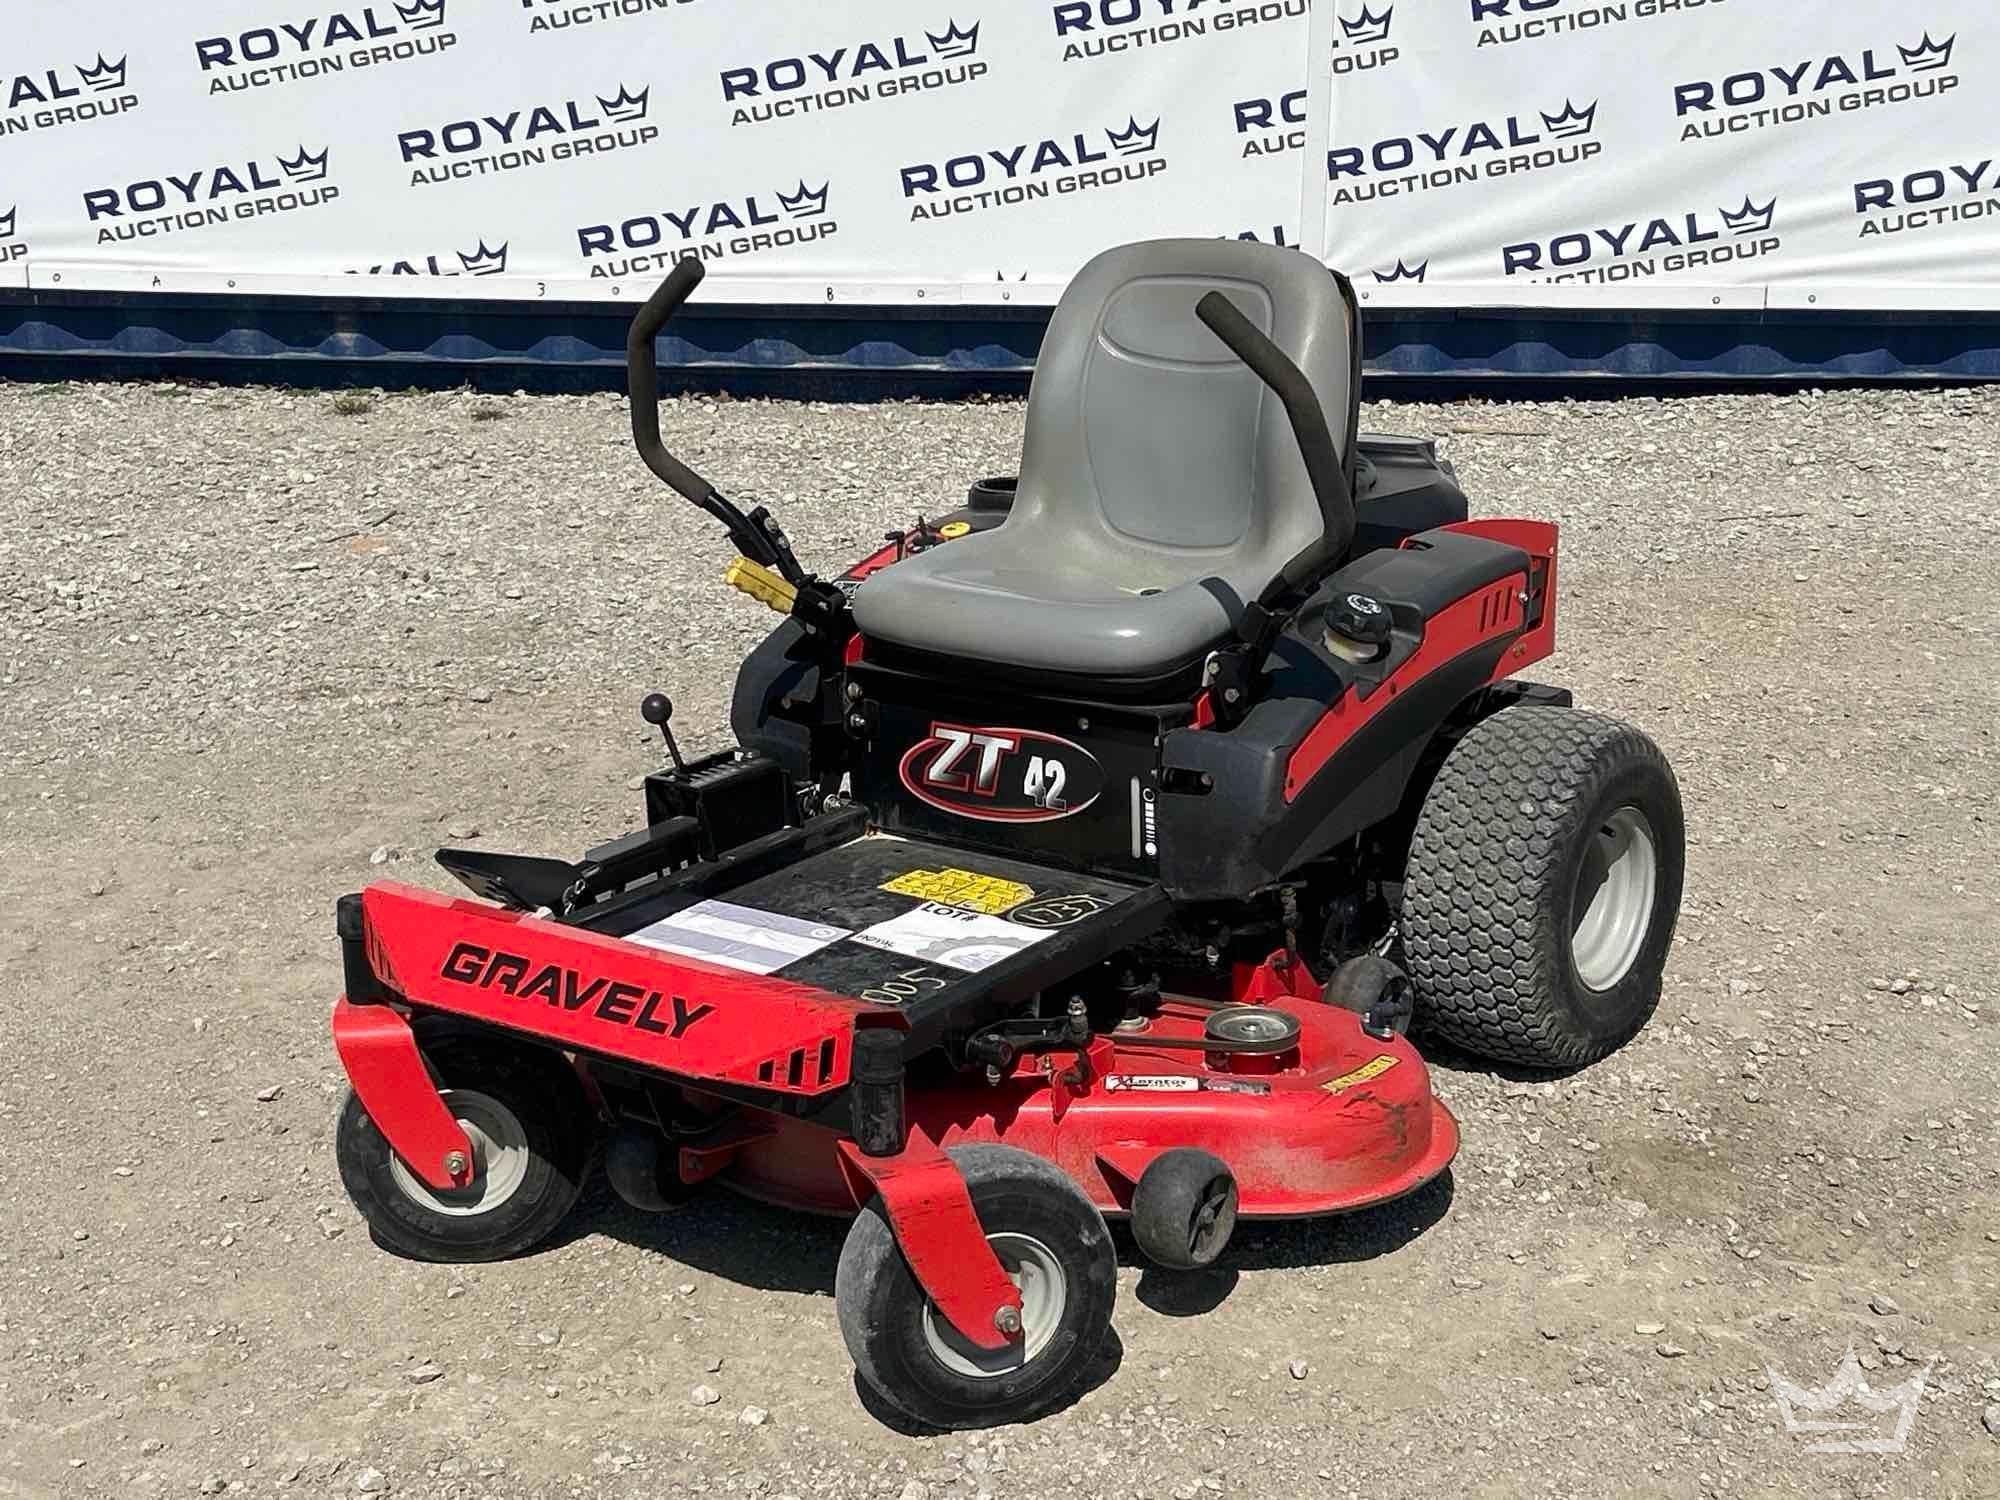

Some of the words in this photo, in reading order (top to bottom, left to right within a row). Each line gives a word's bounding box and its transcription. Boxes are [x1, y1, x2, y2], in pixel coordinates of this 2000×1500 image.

[195, 8, 397, 70] ROYAL
[1064, 19, 1205, 61] AUCTION
[1214, 0, 1311, 30] GROU
[1478, 4, 1626, 47] AUCTION
[0, 70, 80, 108] AL
[209, 56, 343, 95] AUCTION
[350, 33, 456, 69] GROUP
[720, 37, 927, 101] ROYAL
[732, 85, 869, 126] AUCTION
[877, 63, 987, 97] GROUP
[1675, 50, 1895, 116] ROYAL
[35, 95, 138, 128] GROUP
[398, 102, 599, 162] ROYAL
[1681, 99, 1830, 141] AUCTION
[1840, 76, 1958, 110] GROUP
[412, 148, 545, 186] AUCTION
[552, 127, 658, 166] GROUP
[900, 134, 1106, 197] ROYAL
[1327, 117, 1539, 180] ROYAL
[1333, 165, 1477, 205] AUCTION
[1486, 142, 1601, 178] GROUP
[84, 162, 281, 220] ROYAL
[98, 207, 228, 244] AUCTION
[235, 186, 338, 218] GROUP
[911, 182, 1048, 221] AUCTION
[1056, 159, 1166, 193] GROUP
[1854, 160, 2000, 213] ROY
[578, 197, 778, 257] ROYAL
[731, 222, 838, 254] GROUP
[1503, 213, 1718, 275] ROYAL
[1664, 238, 1779, 271] GROUP
[925, 723, 1019, 793] ZT
[1024, 755, 1067, 808] 42
[921, 903, 978, 922] LOT#
[441, 942, 715, 1039] GRAVELY
[861, 967, 947, 1004] 005
